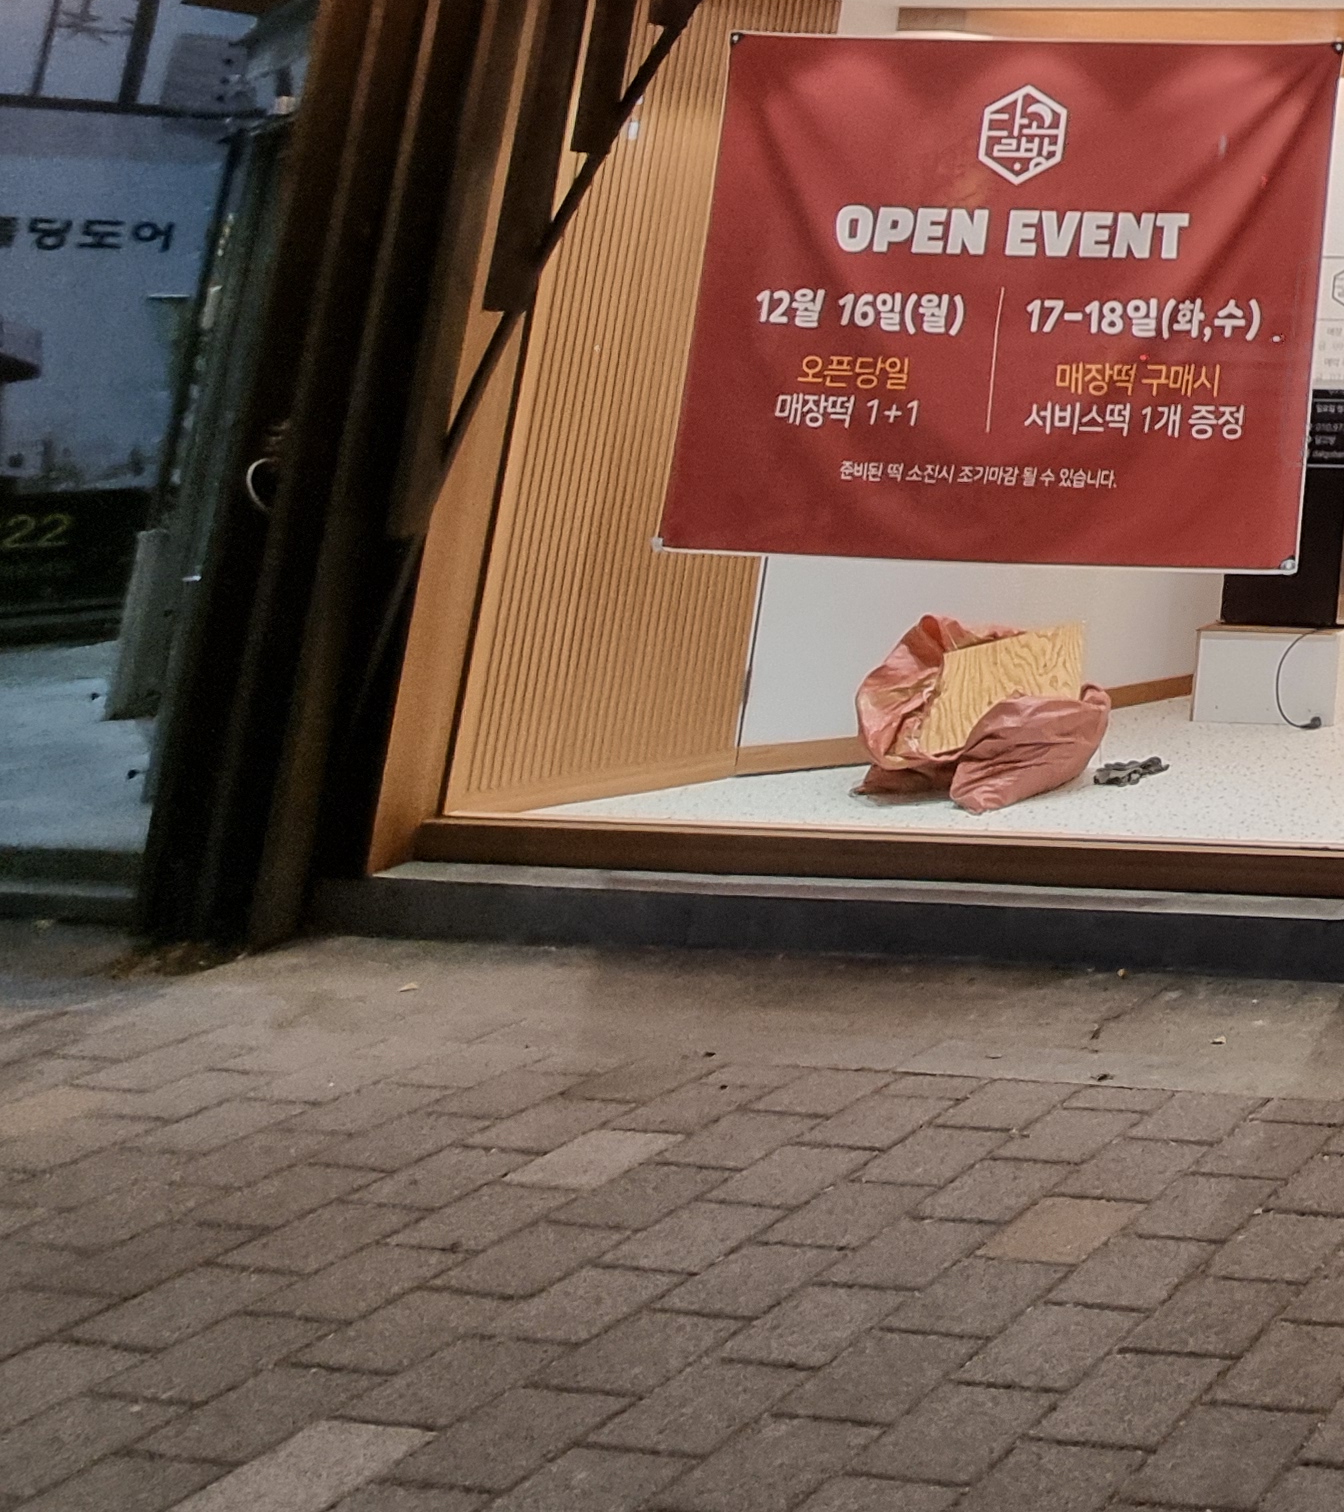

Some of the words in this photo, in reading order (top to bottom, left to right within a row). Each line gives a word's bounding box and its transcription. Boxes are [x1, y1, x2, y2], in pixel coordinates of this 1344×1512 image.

[835, 204, 990, 255] OPEN
[1004, 208, 1190, 260] EVENT
[756, 288, 826, 329] 12월
[838, 292, 966, 337] 16일(월)
[1026, 297, 1262, 342] 17-18일(화,수)
[797, 354, 910, 390] 오픈당일
[1055, 361, 1137, 396] 매장떡
[1141, 363, 1221, 398] 구매시
[774, 392, 856, 429] 매장떡
[866, 398, 920, 427] 1+1
[1024, 400, 1132, 437] 서비스떡
[1141, 403, 1182, 438] 1개
[1188, 404, 1245, 440] 증정
[839, 460, 883, 482] 준비된
[886, 462, 904, 481] 떡
[905, 464, 955, 484] 소진시
[957, 465, 1018, 486] 조기마감
[1040, 468, 1055, 487] 수
[1059, 468, 1118, 489] 있습니다.
